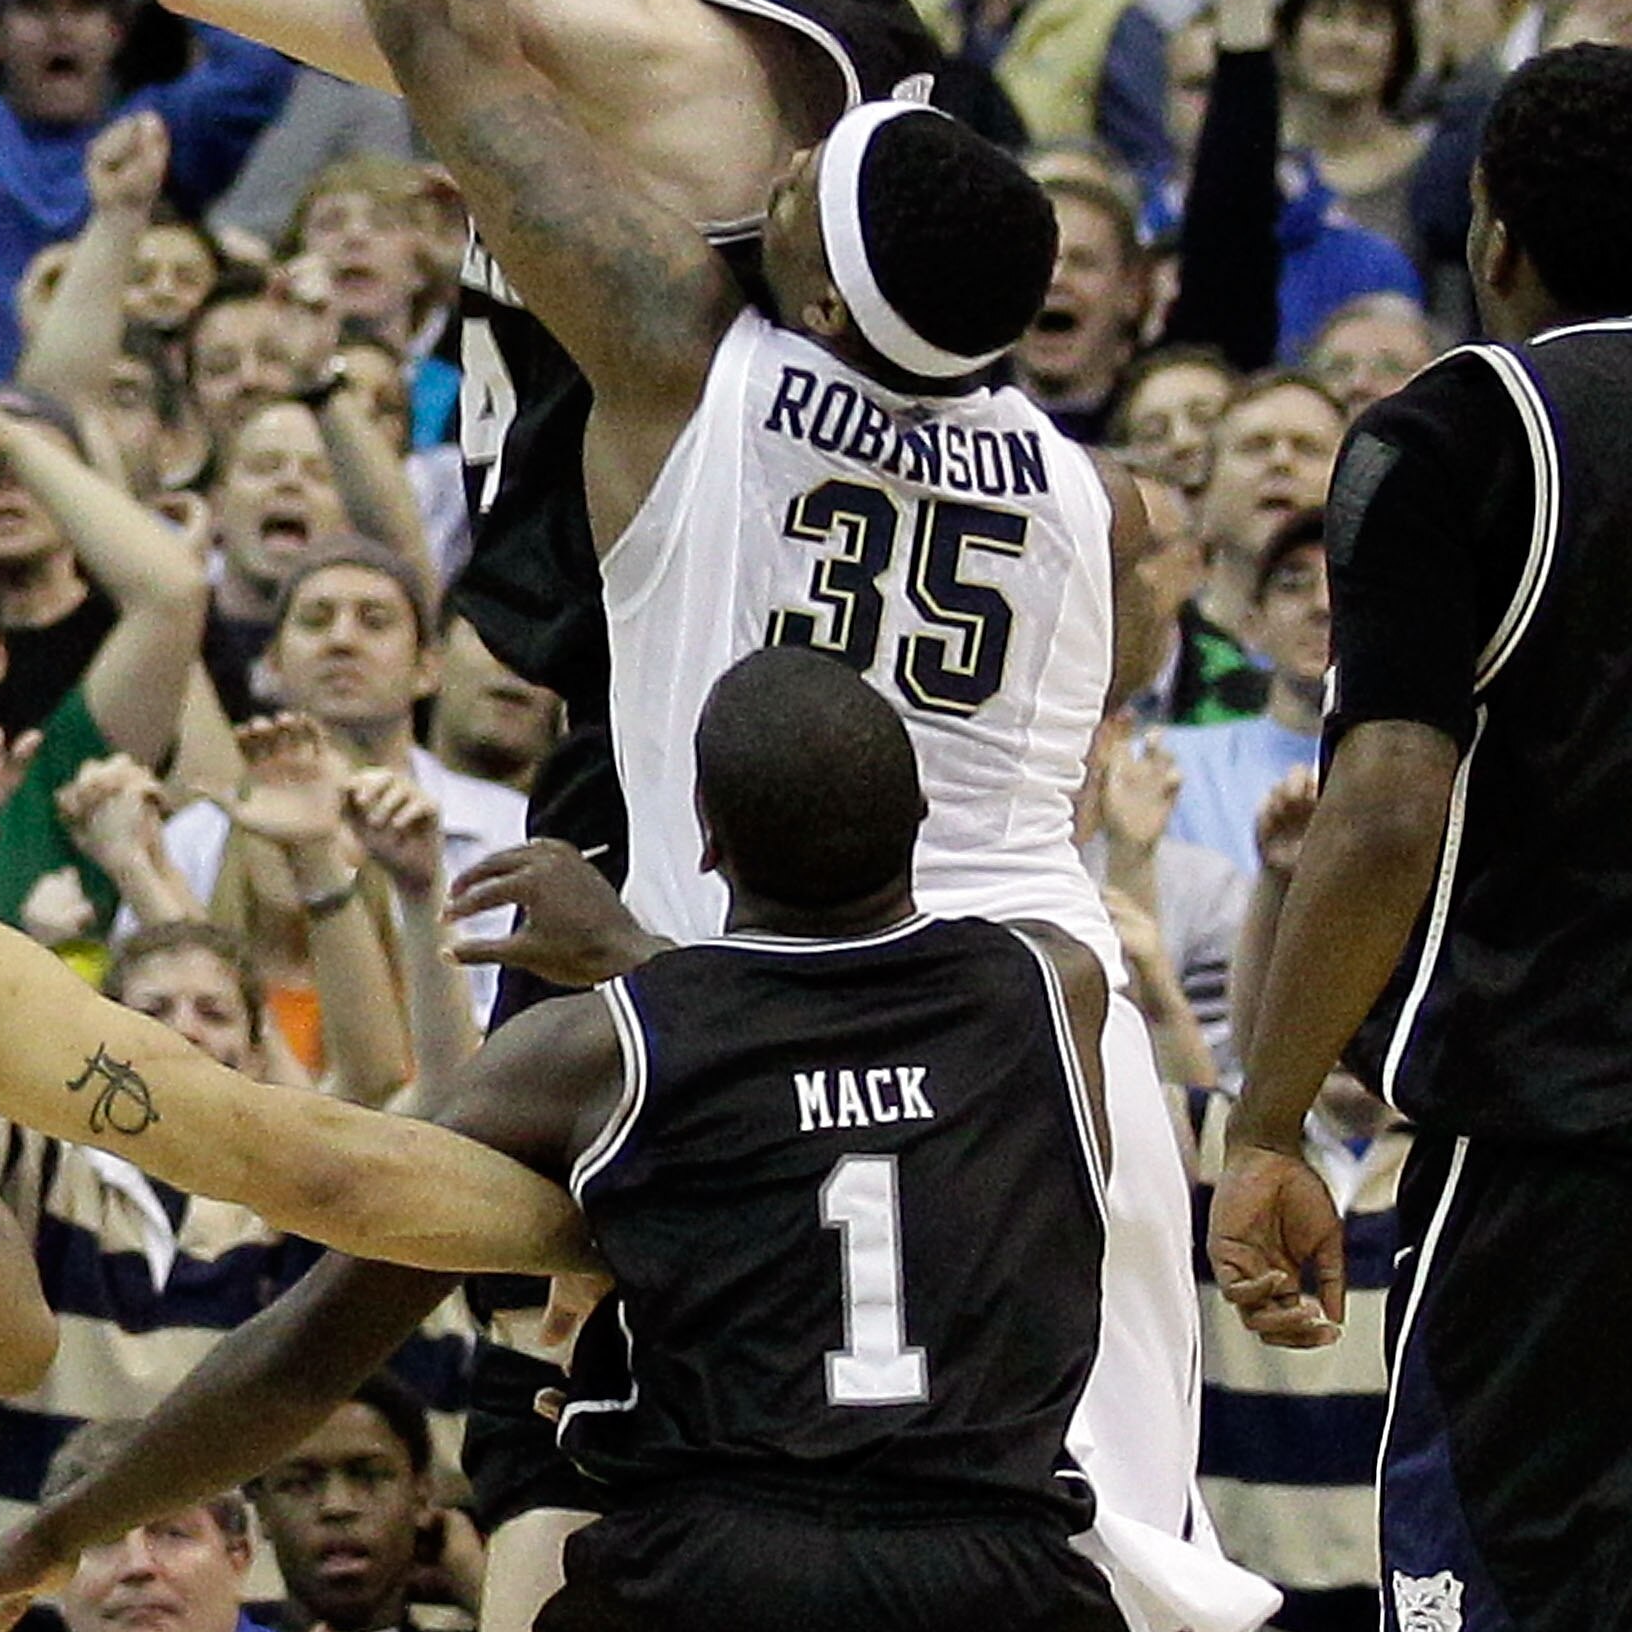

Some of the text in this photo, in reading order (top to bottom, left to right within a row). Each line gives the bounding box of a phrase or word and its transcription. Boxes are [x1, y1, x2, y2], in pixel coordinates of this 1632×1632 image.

[764, 365, 1049, 495] ROBINSON
[765, 477, 1031, 718] 35
[794, 1066, 935, 1132] MACK
[819, 1152, 930, 1406] 1
